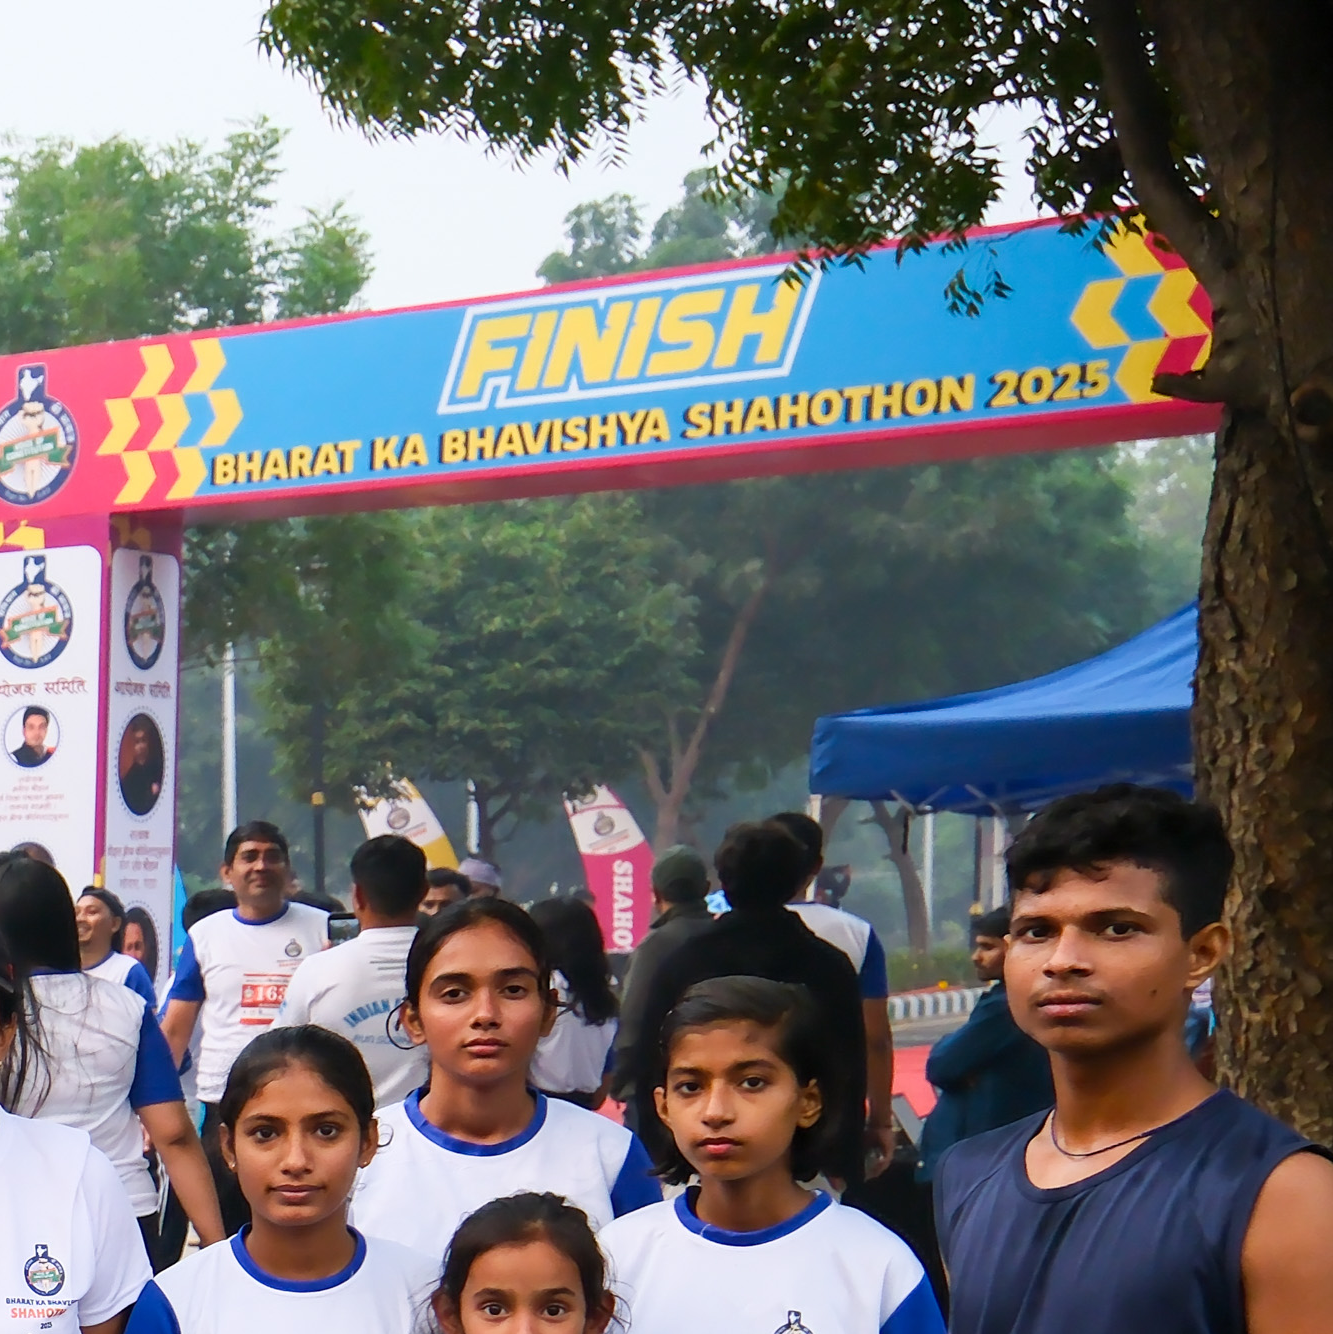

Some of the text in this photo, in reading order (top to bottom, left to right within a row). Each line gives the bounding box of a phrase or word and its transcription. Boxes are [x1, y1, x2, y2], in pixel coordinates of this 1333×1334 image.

[457, 279, 802, 398] FINISH
[212, 360, 1109, 486] BHARAT KA BHAVISHYA SHAHOTHON 2025
[613, 860, 633, 950] SHAHO
[256, 986, 287, 1000] 163
